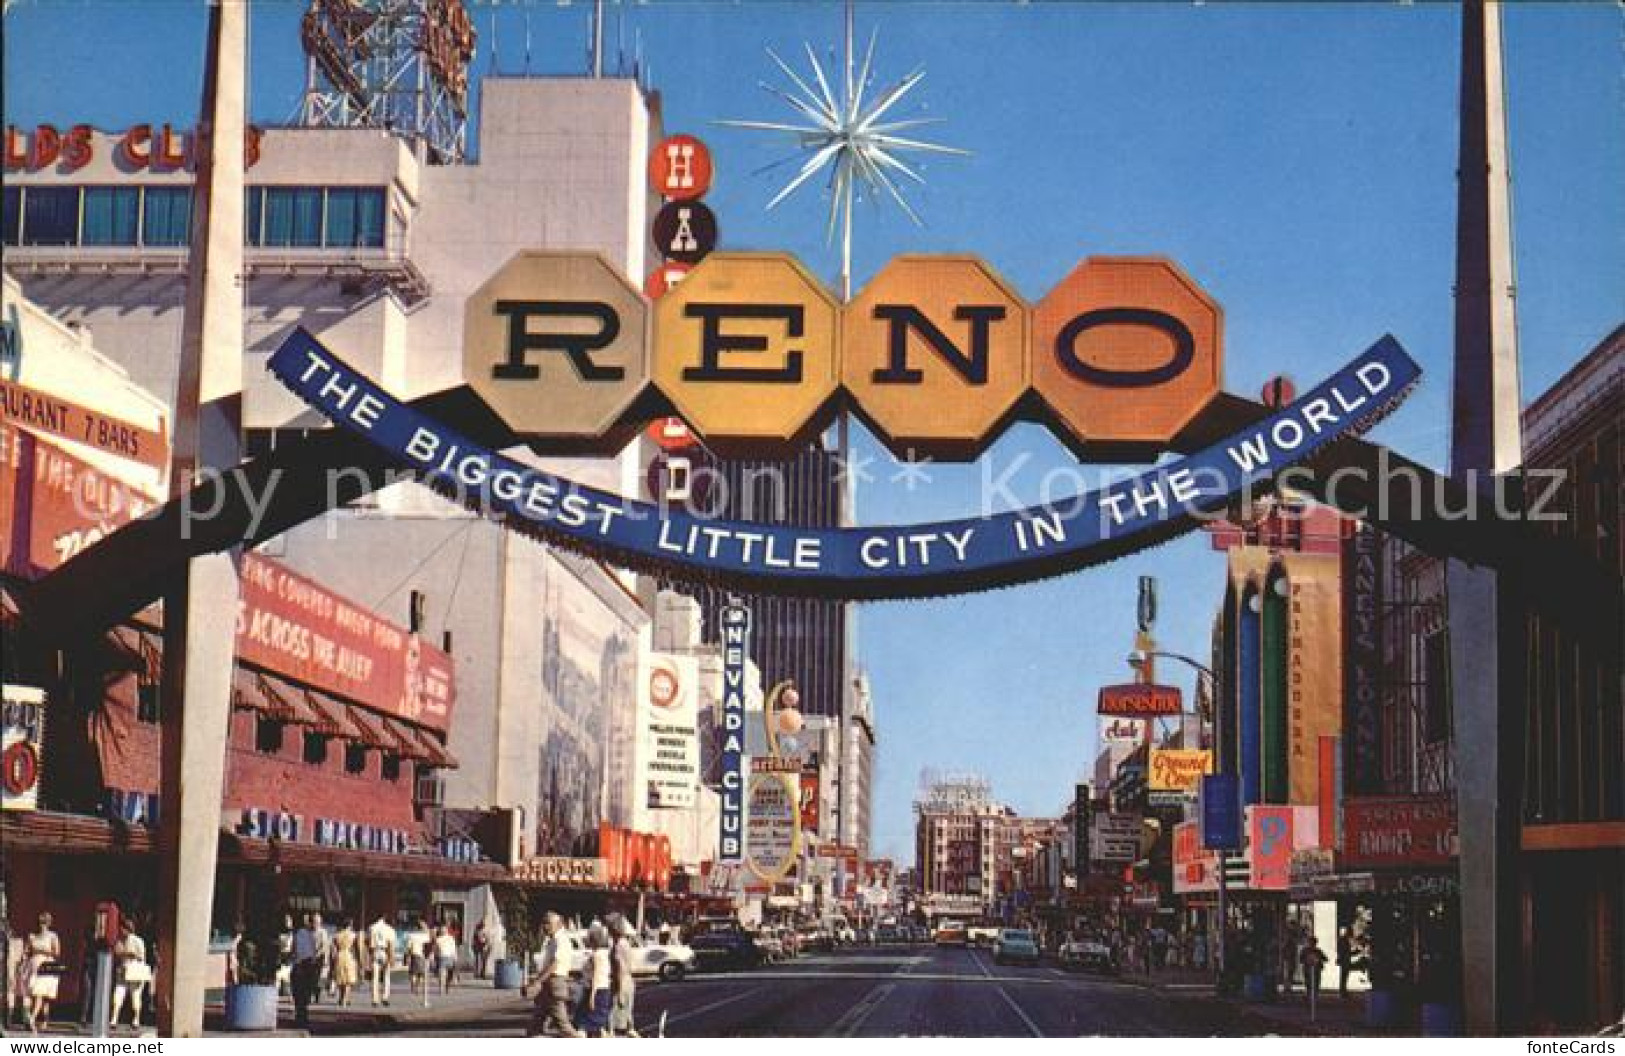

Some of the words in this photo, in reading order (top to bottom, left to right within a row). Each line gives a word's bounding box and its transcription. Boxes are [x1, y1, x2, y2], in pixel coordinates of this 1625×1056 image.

[118, 124, 263, 170] CLB
[492, 299, 1196, 389] RENO
[85, 415, 94, 441] 7
[98, 418, 139, 456] BARS
[299, 350, 386, 430] THE
[404, 425, 624, 537] BIGGEST
[656, 518, 822, 569] LITTLE
[859, 528, 974, 569] CITY
[1013, 512, 1067, 551] IN
[1097, 467, 1201, 527] THE
[1227, 360, 1391, 473] WORLD
[250, 607, 311, 660] ACROSS
[725, 625, 742, 751] NEVADA
[722, 771, 741, 854] CLUB
